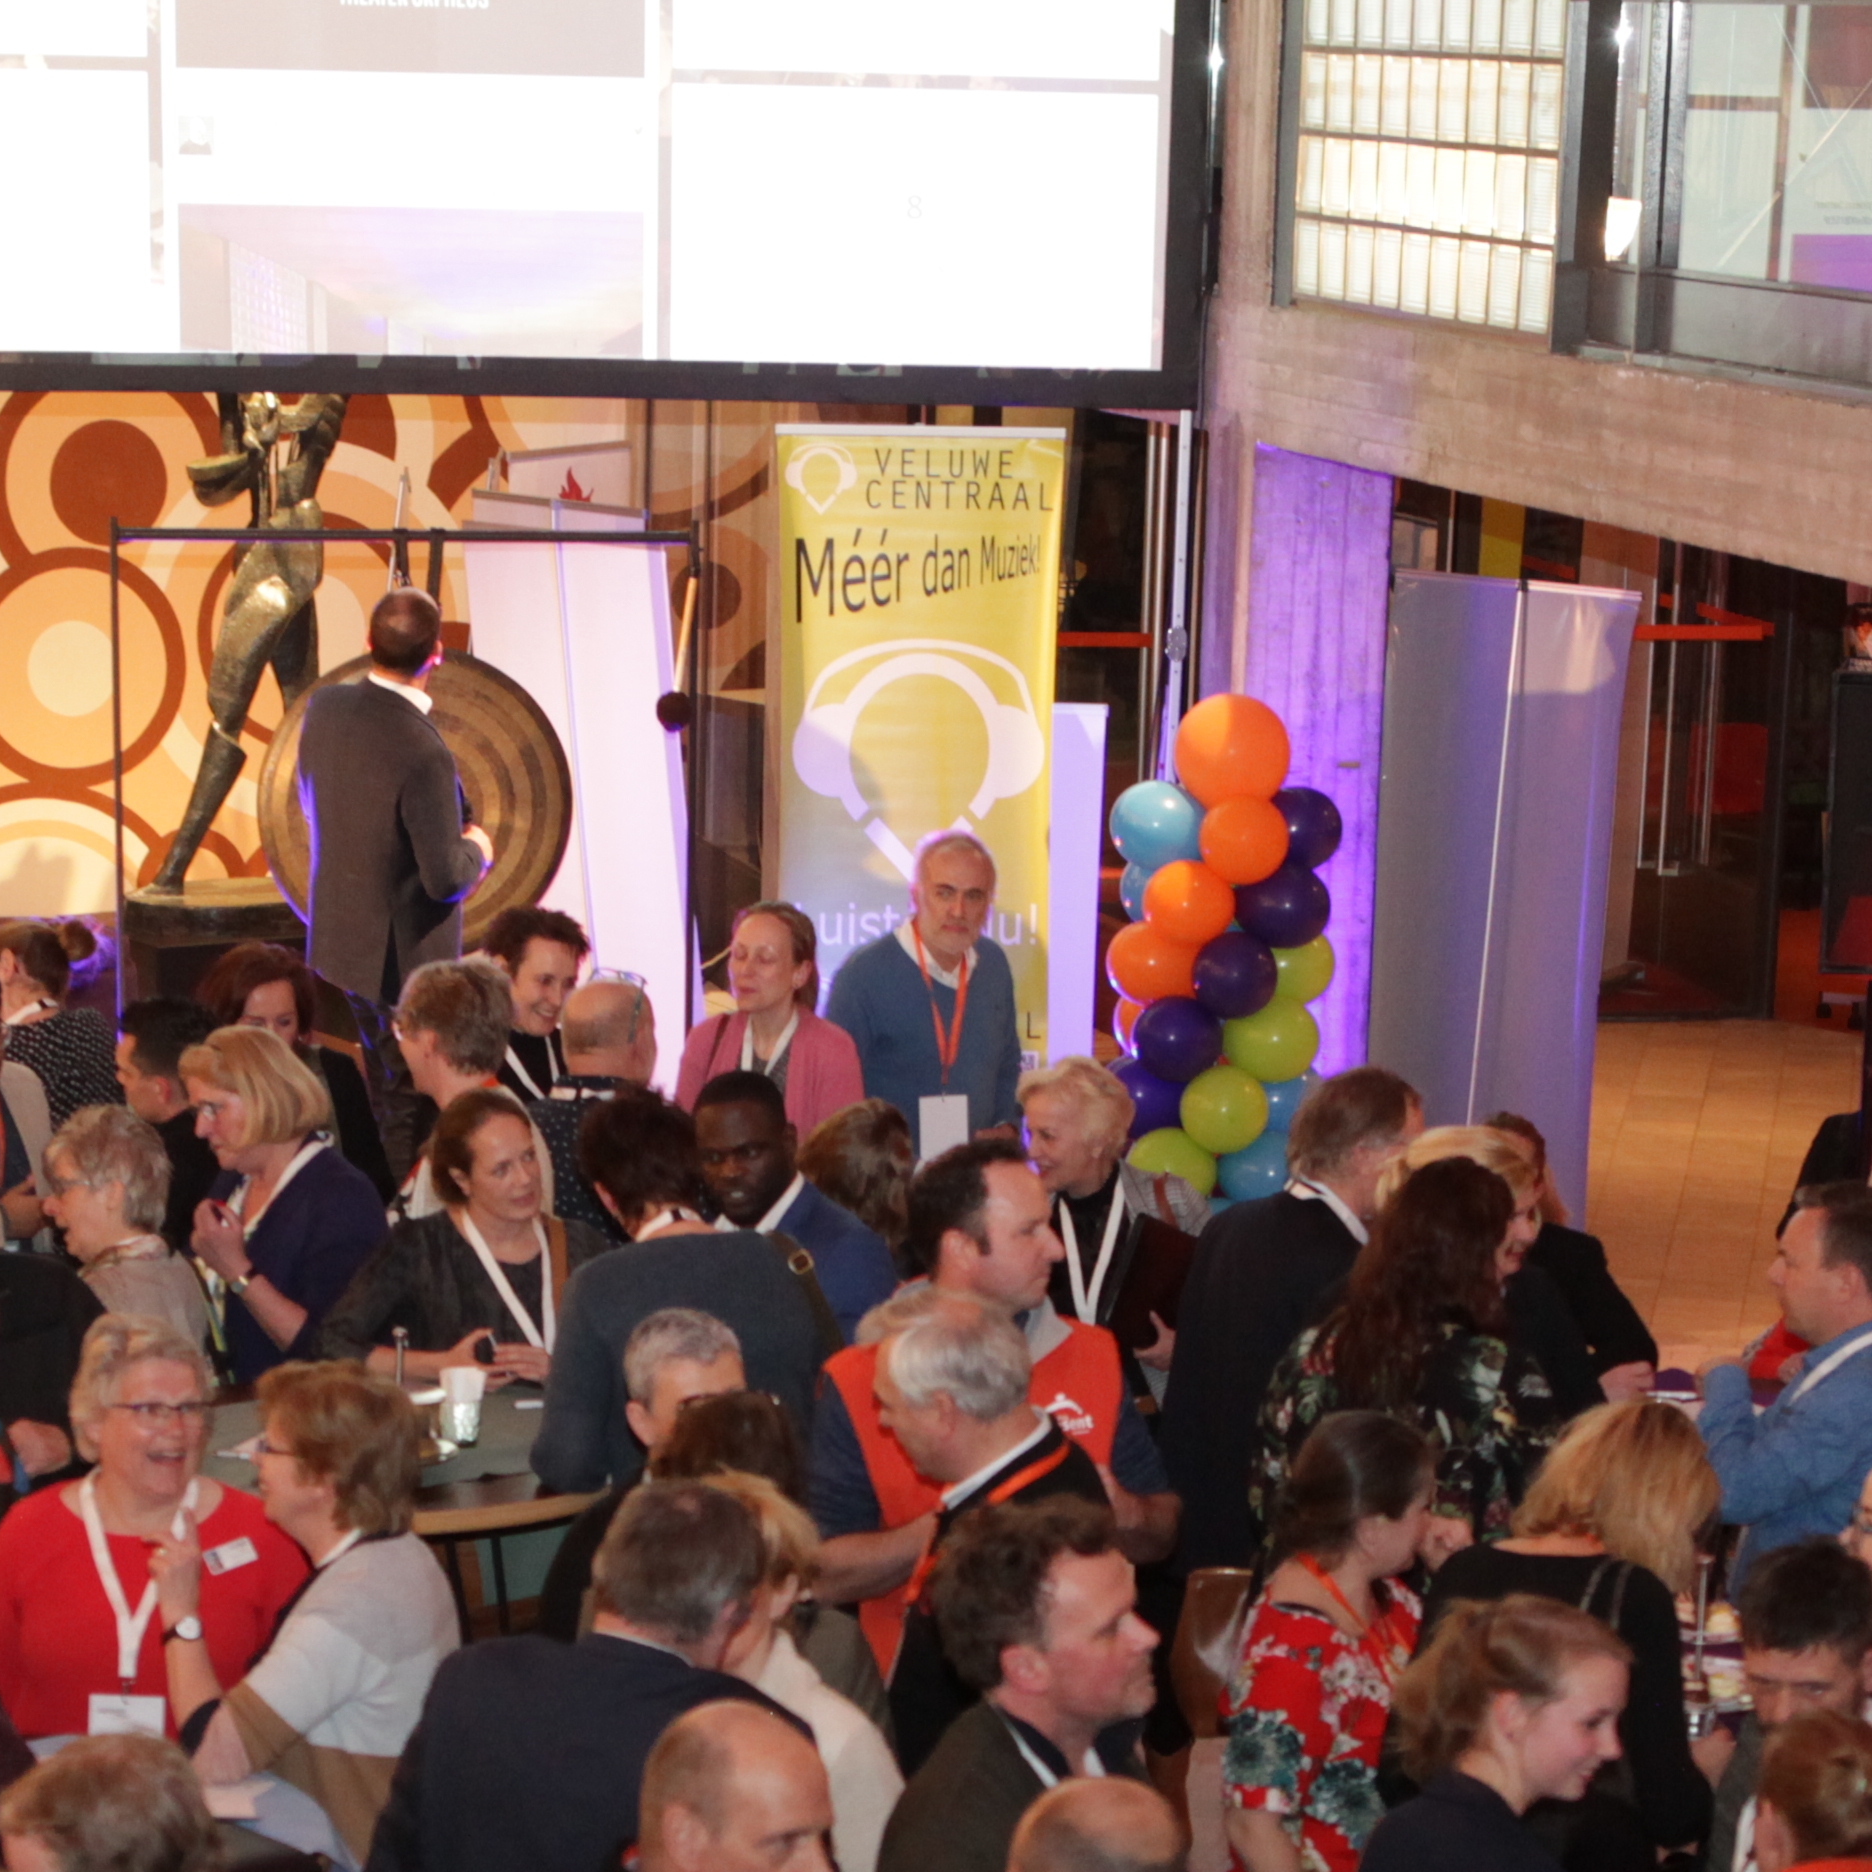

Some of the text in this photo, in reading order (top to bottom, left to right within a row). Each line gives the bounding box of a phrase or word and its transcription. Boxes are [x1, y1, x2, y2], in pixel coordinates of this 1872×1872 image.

[874, 448, 1014, 480] VELUWE
[866, 480, 1054, 512] CENTRAAL
[795, 528, 1041, 624] Méér dan Muziek!
